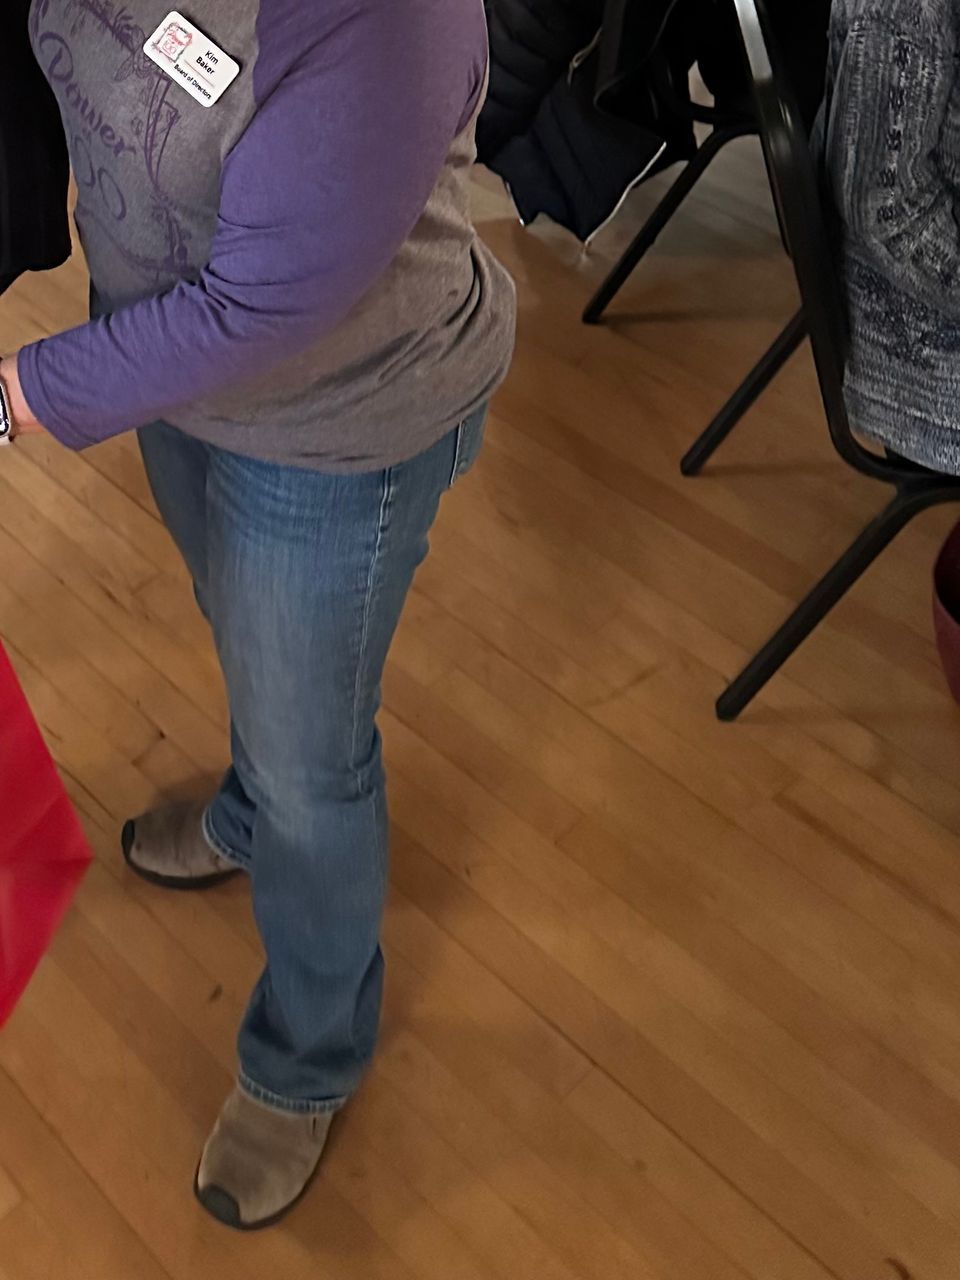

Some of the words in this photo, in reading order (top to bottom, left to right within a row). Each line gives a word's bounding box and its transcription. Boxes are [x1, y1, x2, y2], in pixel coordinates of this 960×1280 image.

[195, 56, 216, 76] Baker
[204, 50, 219, 65] Kim
[39, 31, 137, 157] Power
[173, 63, 189, 78] Board
[187, 74, 194, 82] of
[191, 79, 212, 100] Directors
